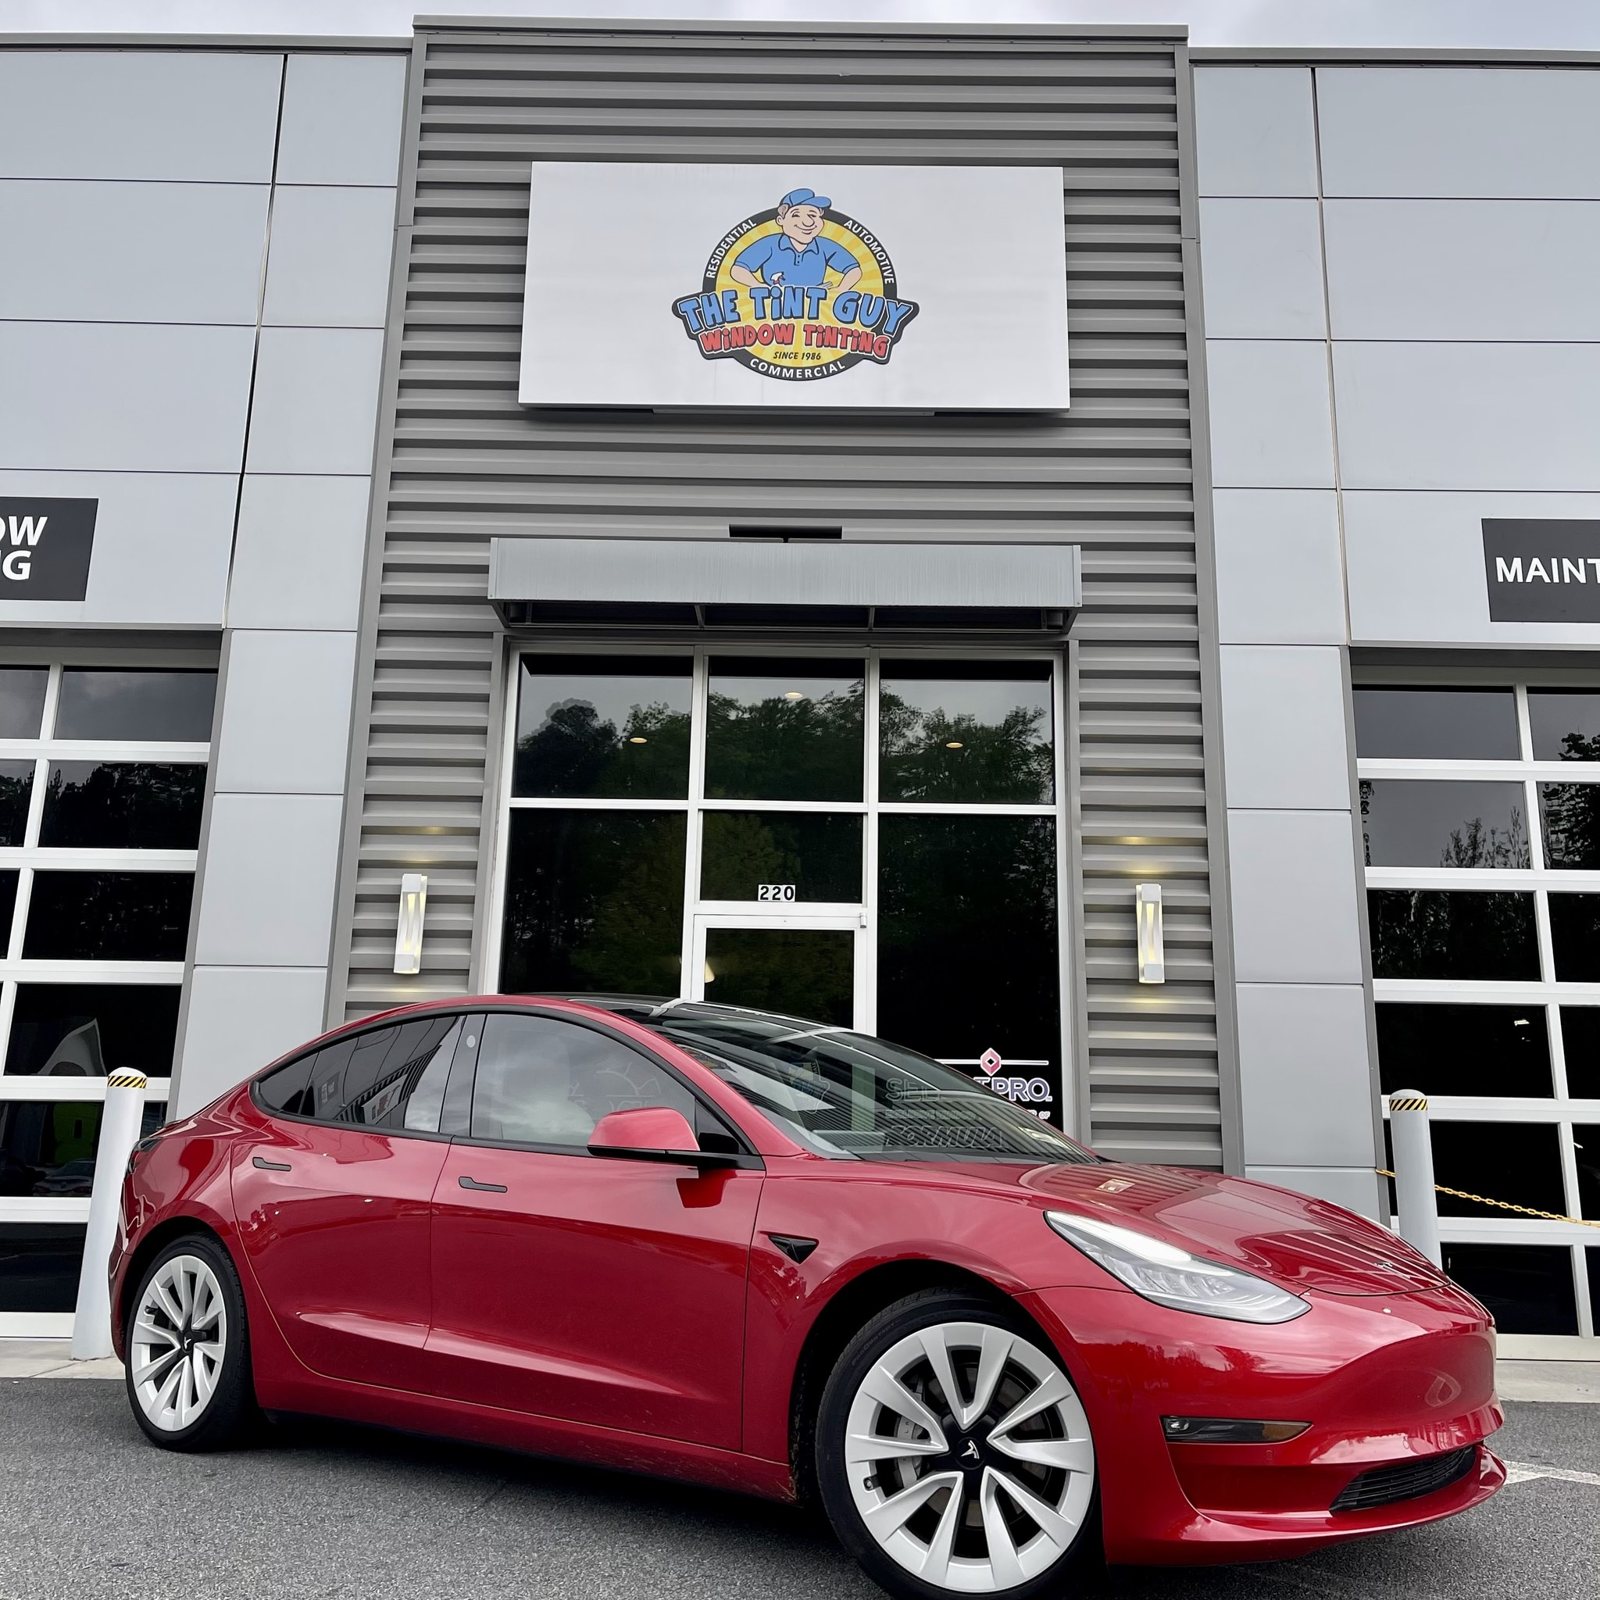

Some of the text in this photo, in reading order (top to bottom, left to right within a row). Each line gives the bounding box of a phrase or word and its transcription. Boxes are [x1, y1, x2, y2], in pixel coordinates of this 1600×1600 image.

[705, 219, 757, 279] RESIDENTIAL
[844, 220, 895, 285] AUTOMOTIVE
[678, 289, 741, 333] THE
[832, 291, 912, 335] GUY
[750, 359, 846, 379] COMMERCIAL
[773, 351, 822, 361] SINCE 1986
[0, 516, 48, 546] W
[759, 885, 795, 901] 220
